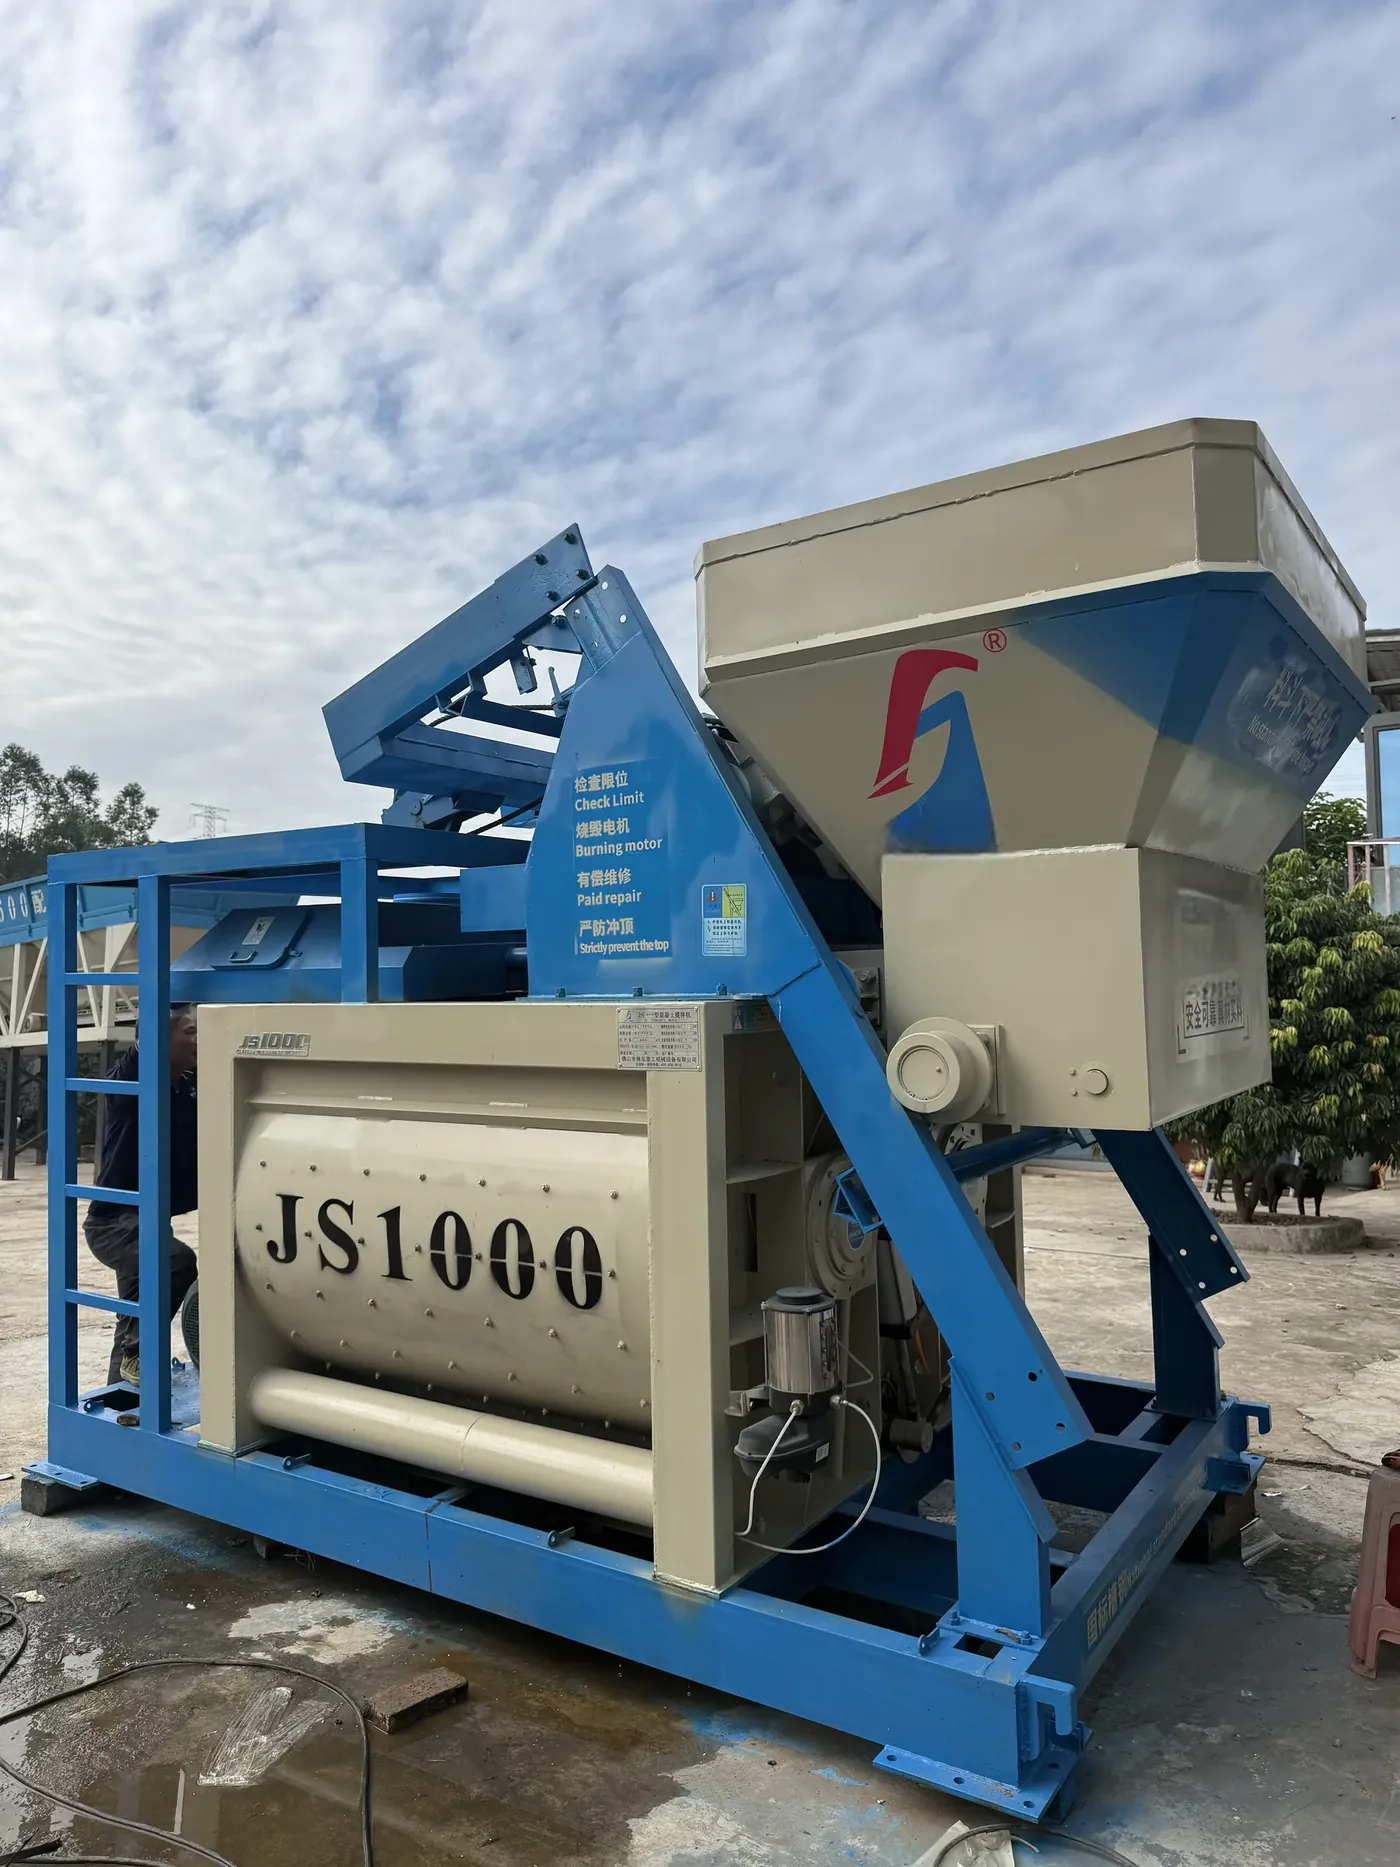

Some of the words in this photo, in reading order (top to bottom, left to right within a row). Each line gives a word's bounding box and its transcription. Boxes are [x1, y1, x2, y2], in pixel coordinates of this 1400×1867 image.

[575, 770, 628, 793] 检查限位
[575, 794, 610, 811] Check
[613, 791, 644, 807] Limit
[576, 817, 630, 839] 烧毁电机
[576, 841, 623, 857] Burning
[625, 838, 663, 852] motor
[577, 867, 631, 888] 有偿维修
[577, 892, 602, 906] Paid
[605, 889, 642, 906] repair
[579, 917, 634, 937] 严防冲顶
[580, 941, 607, 955] Strictly
[1185, 999, 1243, 1030] 安全可靠真材实料
[266, 1193, 603, 1310] JS1000
